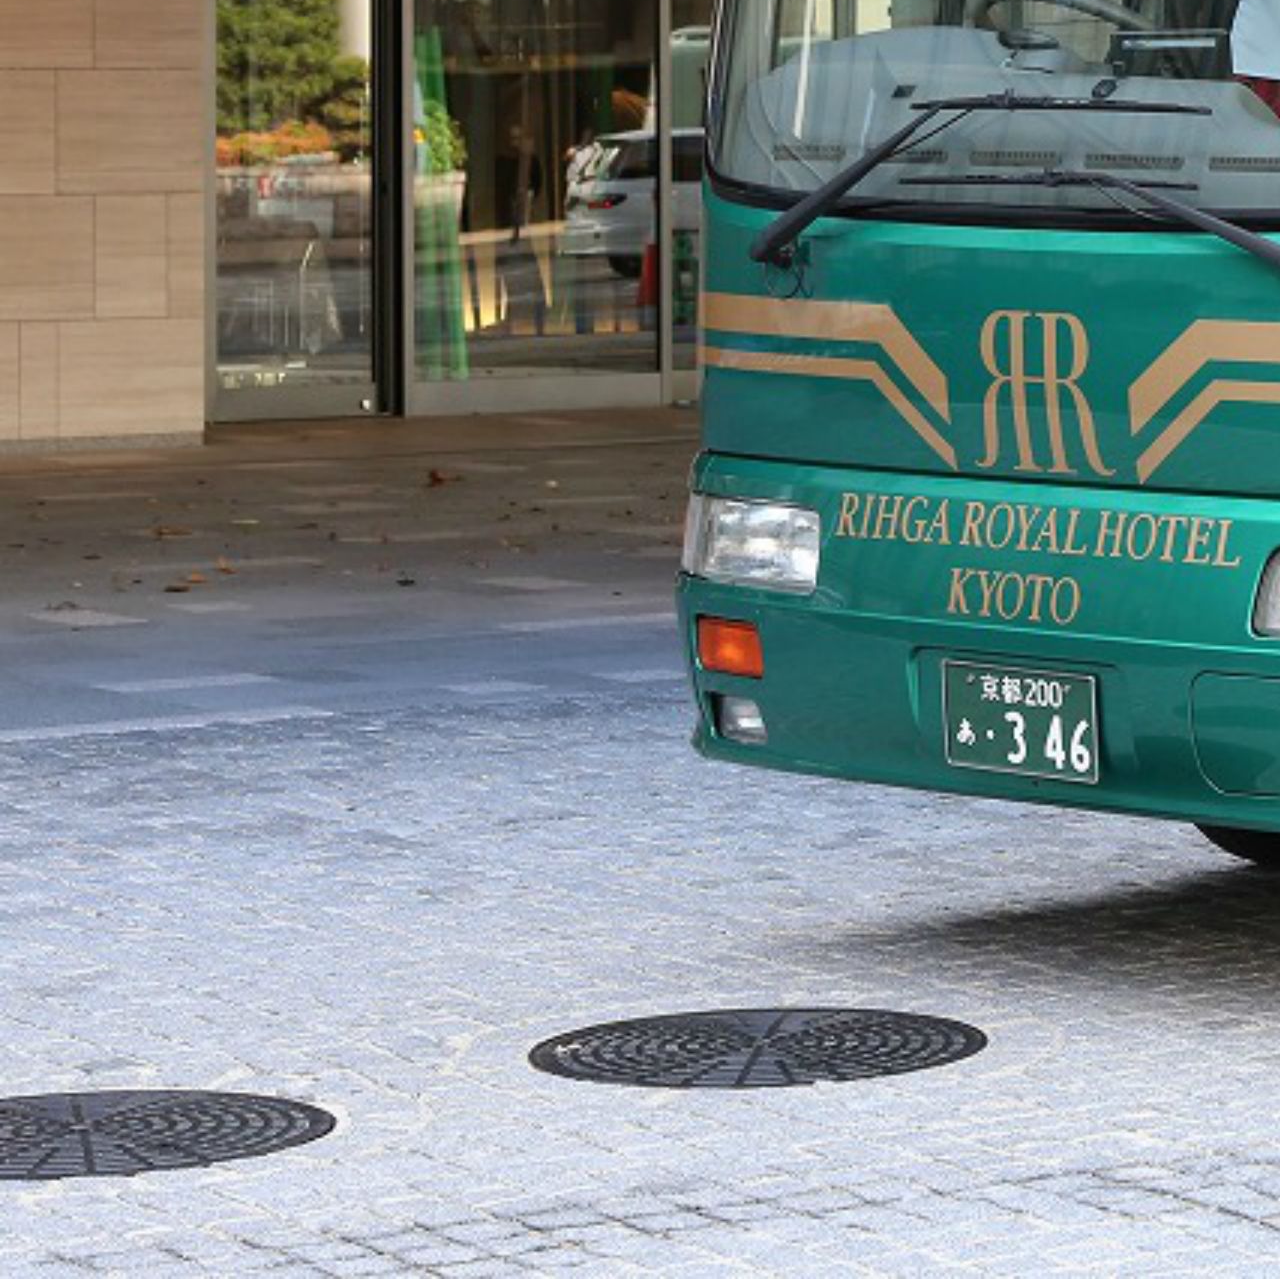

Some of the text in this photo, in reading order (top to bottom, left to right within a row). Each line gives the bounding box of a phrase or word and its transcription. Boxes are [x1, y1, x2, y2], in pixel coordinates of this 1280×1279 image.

[835, 492, 1243, 570] RIHGA ROYAL HOTEL
[947, 567, 1081, 627] KYOTO
